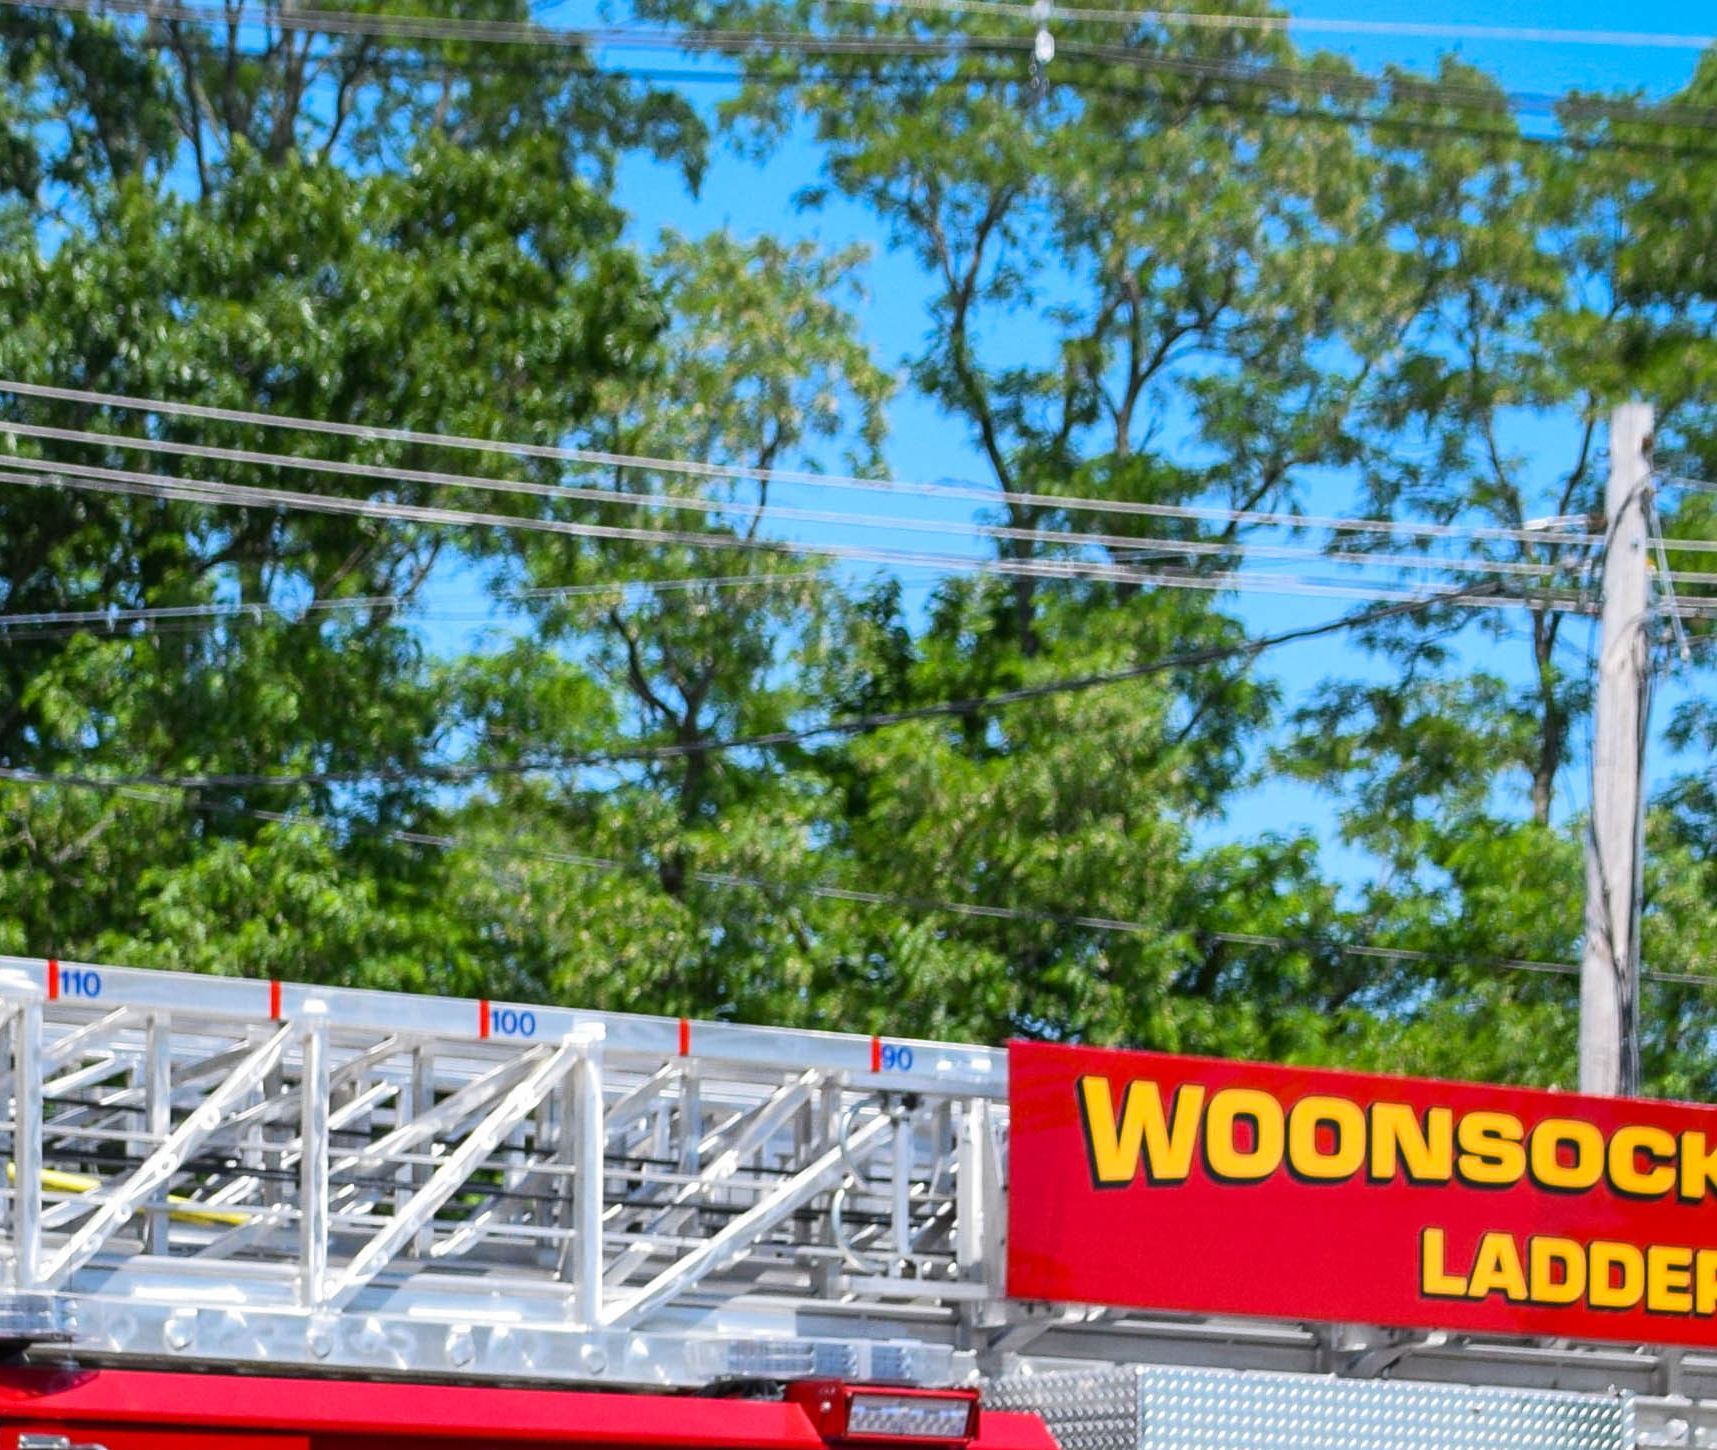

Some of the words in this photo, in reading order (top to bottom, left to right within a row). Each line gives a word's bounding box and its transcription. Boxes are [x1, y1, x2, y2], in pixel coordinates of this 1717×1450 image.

[60, 970, 101, 998] 110
[493, 1010, 535, 1036] 100
[882, 1045, 913, 1071] 90
